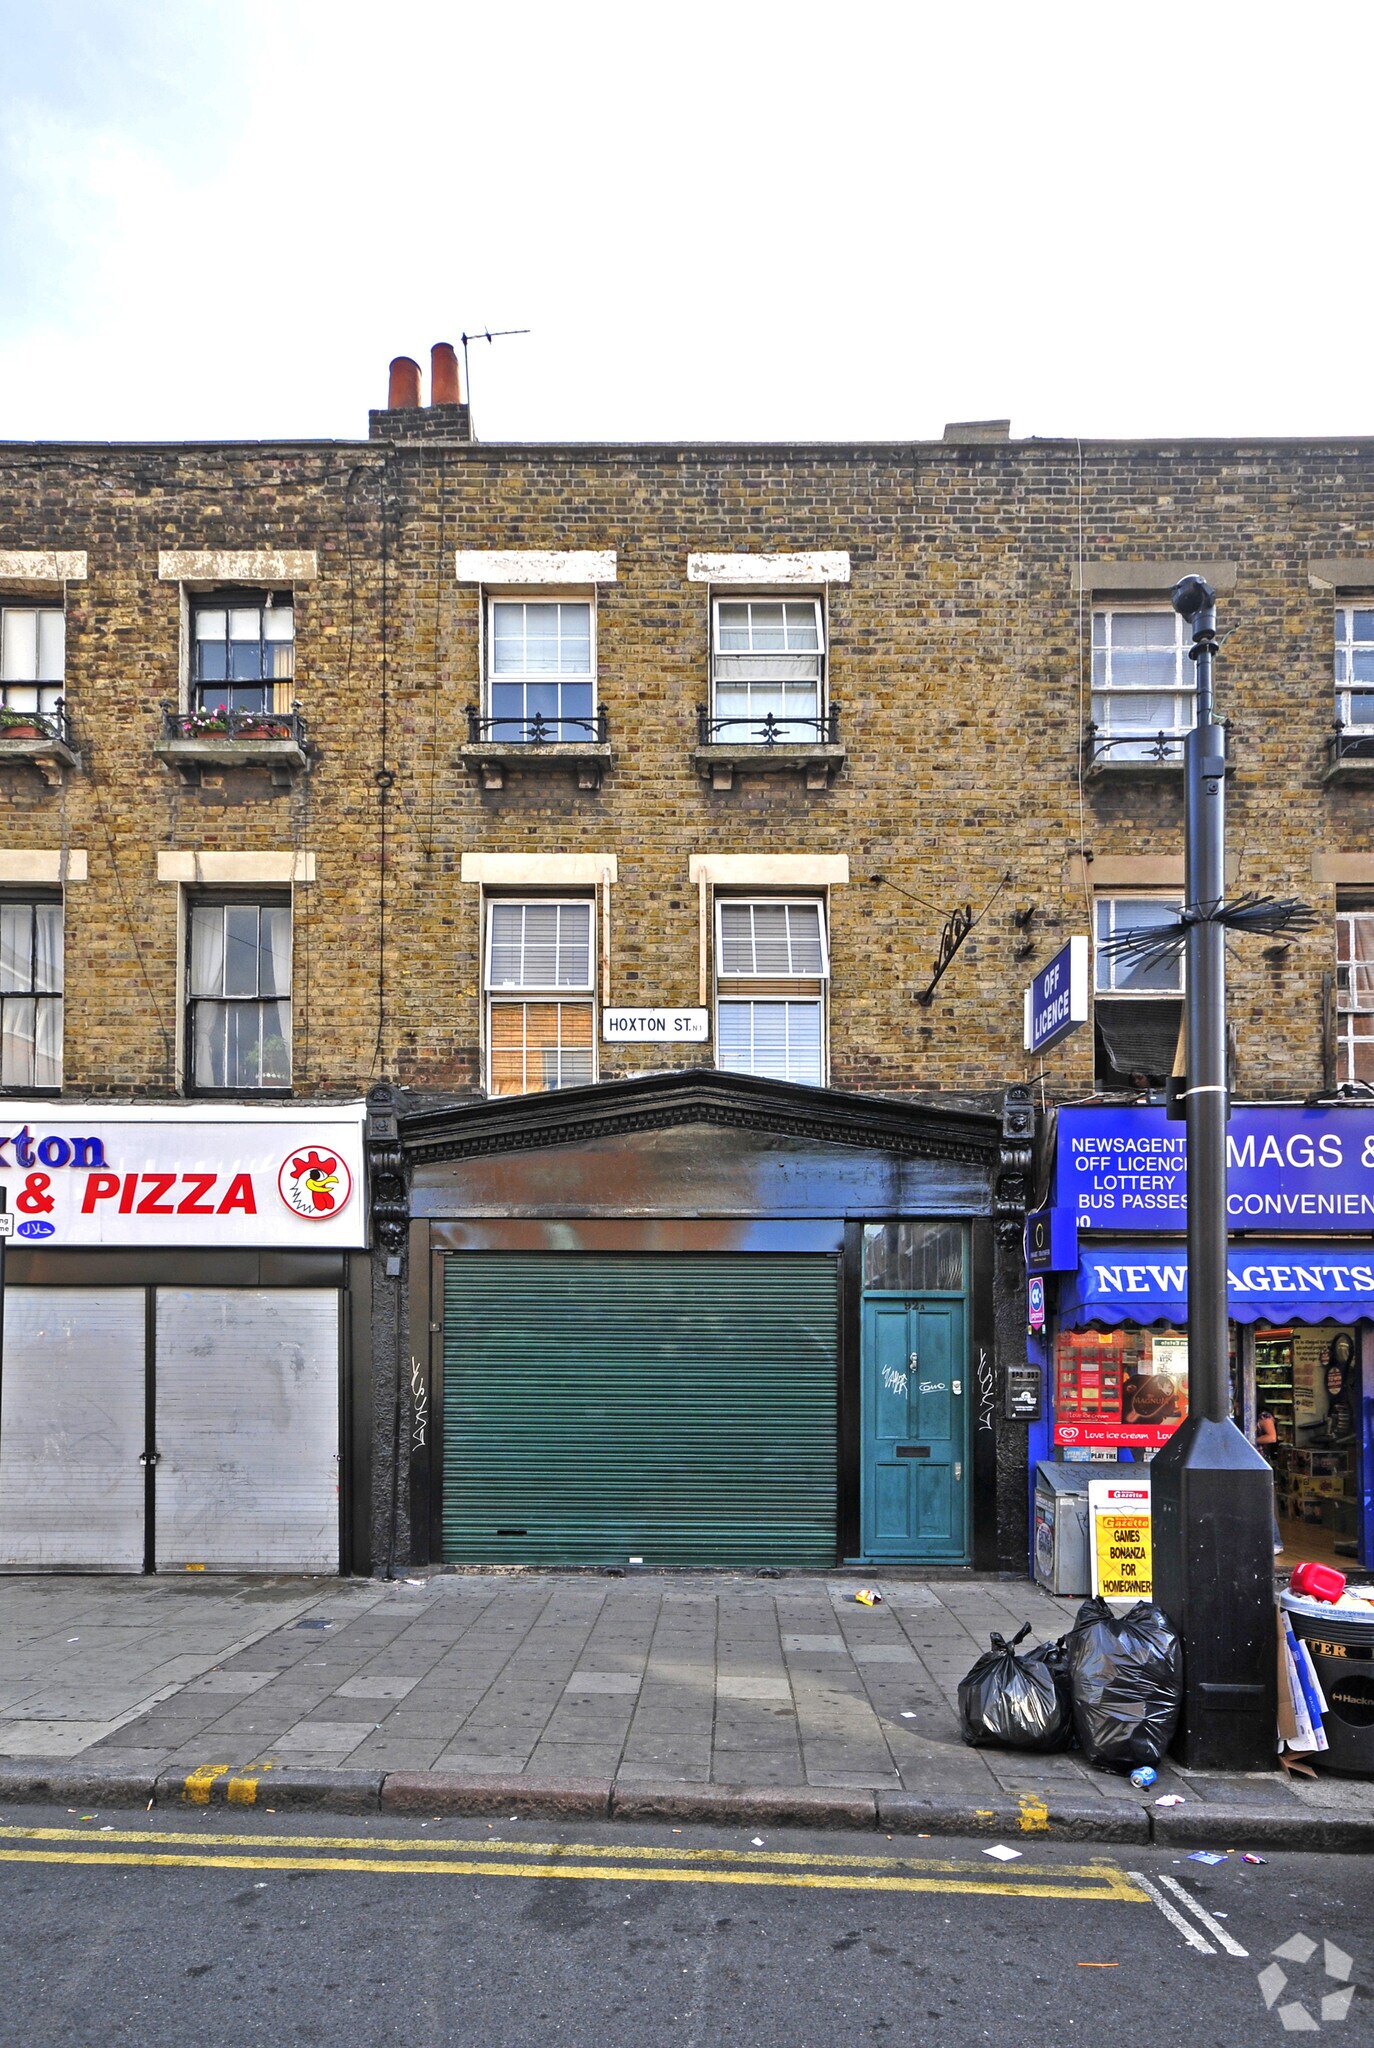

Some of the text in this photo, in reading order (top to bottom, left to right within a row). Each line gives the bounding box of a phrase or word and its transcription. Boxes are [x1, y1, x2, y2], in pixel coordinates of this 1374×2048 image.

[1044, 963, 1060, 999] OFF
[1035, 988, 1070, 1041] LICENCE
[609, 1018, 666, 1031] HOXTON
[1226, 1134, 1343, 1168] MAGS
[1075, 1156, 1187, 1172] OFF LICENC
[1094, 1175, 1176, 1190] LOTTERY
[16, 1172, 258, 1214] & PIZZA
[1079, 1194, 1187, 1209] BUS PASSES
[1084, 1430, 1173, 1440] Love ice cream Lov
[1113, 1490, 1143, 1499] Gazette
[1103, 1517, 1149, 1528] Gazette
[1114, 1530, 1140, 1543] GAMES
[1110, 1547, 1146, 1559] BONANZA
[1121, 1563, 1137, 1576] FOR
